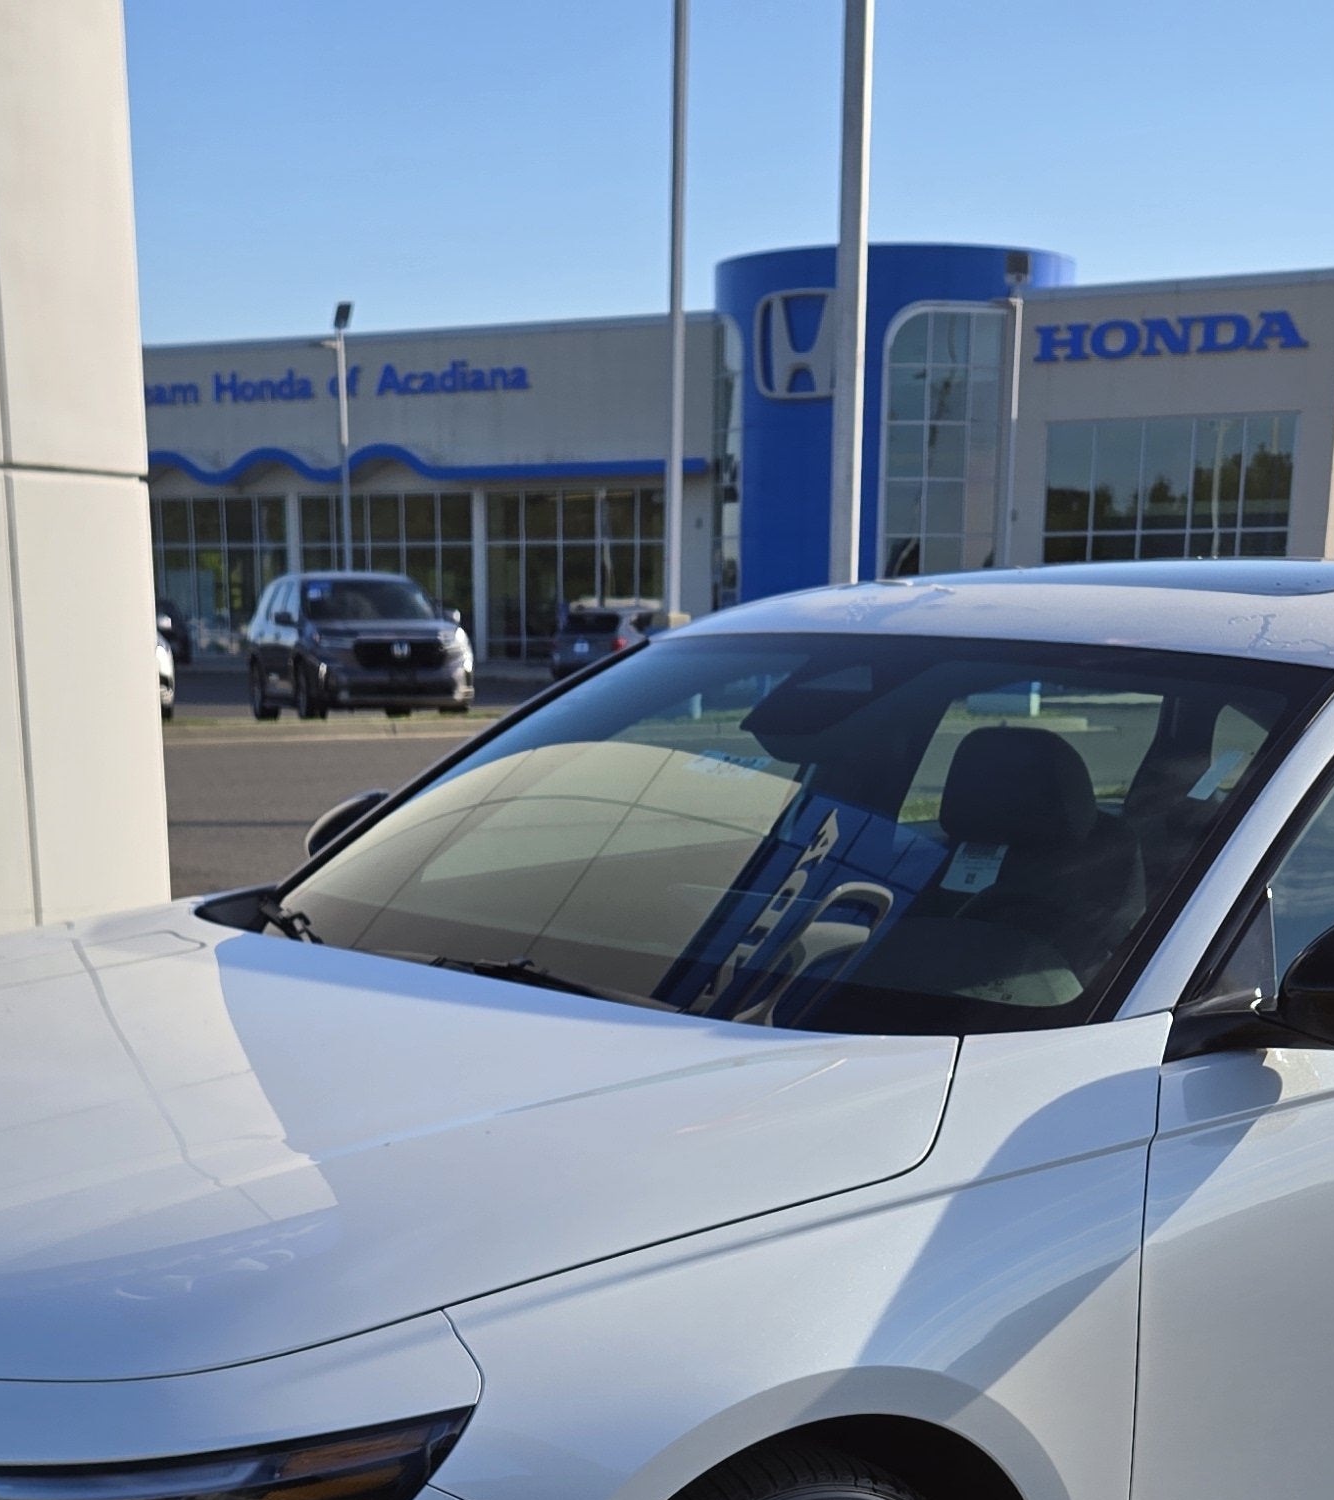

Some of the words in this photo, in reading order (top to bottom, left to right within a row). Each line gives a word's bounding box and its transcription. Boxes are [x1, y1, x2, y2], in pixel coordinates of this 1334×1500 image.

[1033, 310, 1310, 363] HONDA
[213, 369, 314, 403] Honda
[376, 360, 530, 396] Acadiana
